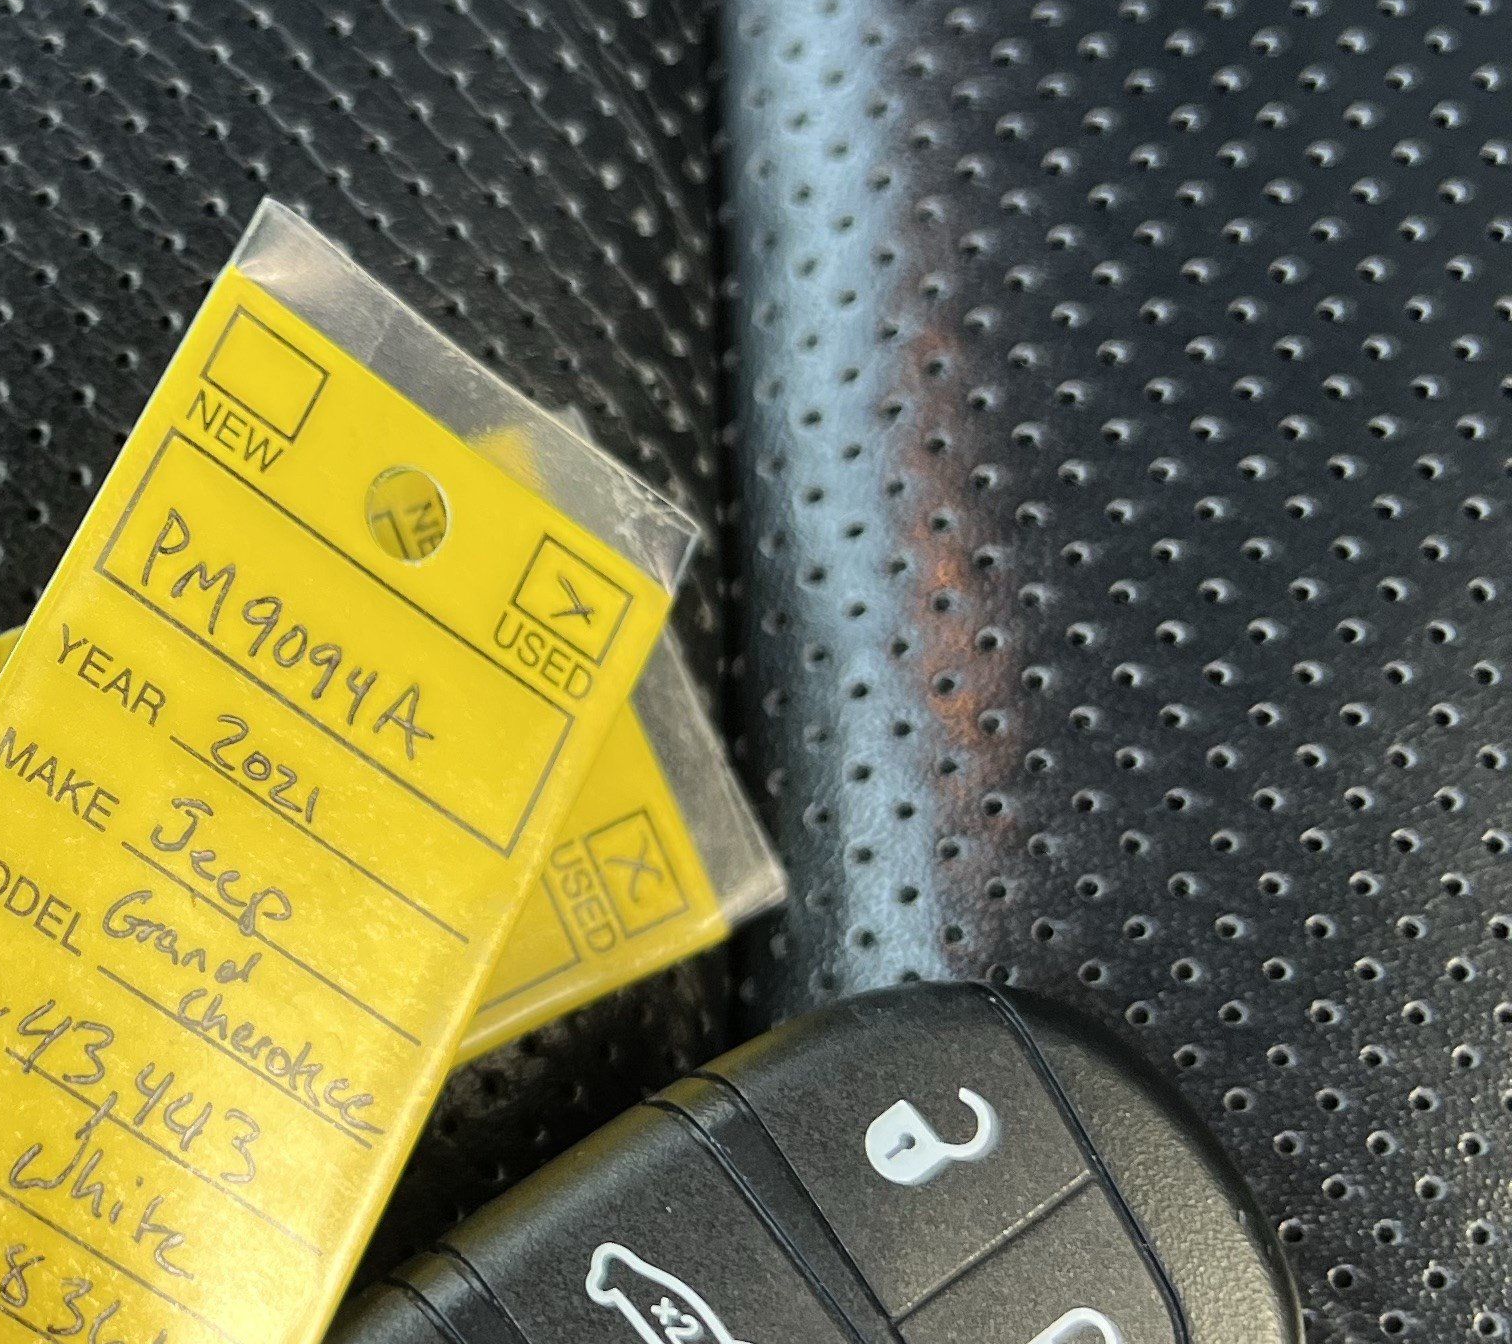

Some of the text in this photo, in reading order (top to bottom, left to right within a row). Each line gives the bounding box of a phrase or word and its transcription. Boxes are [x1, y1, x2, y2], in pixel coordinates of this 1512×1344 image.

[187, 391, 284, 473] NEW
[494, 611, 593, 702] USED
[56, 624, 319, 824] YEAR 2021
[550, 839, 617, 953] USED
